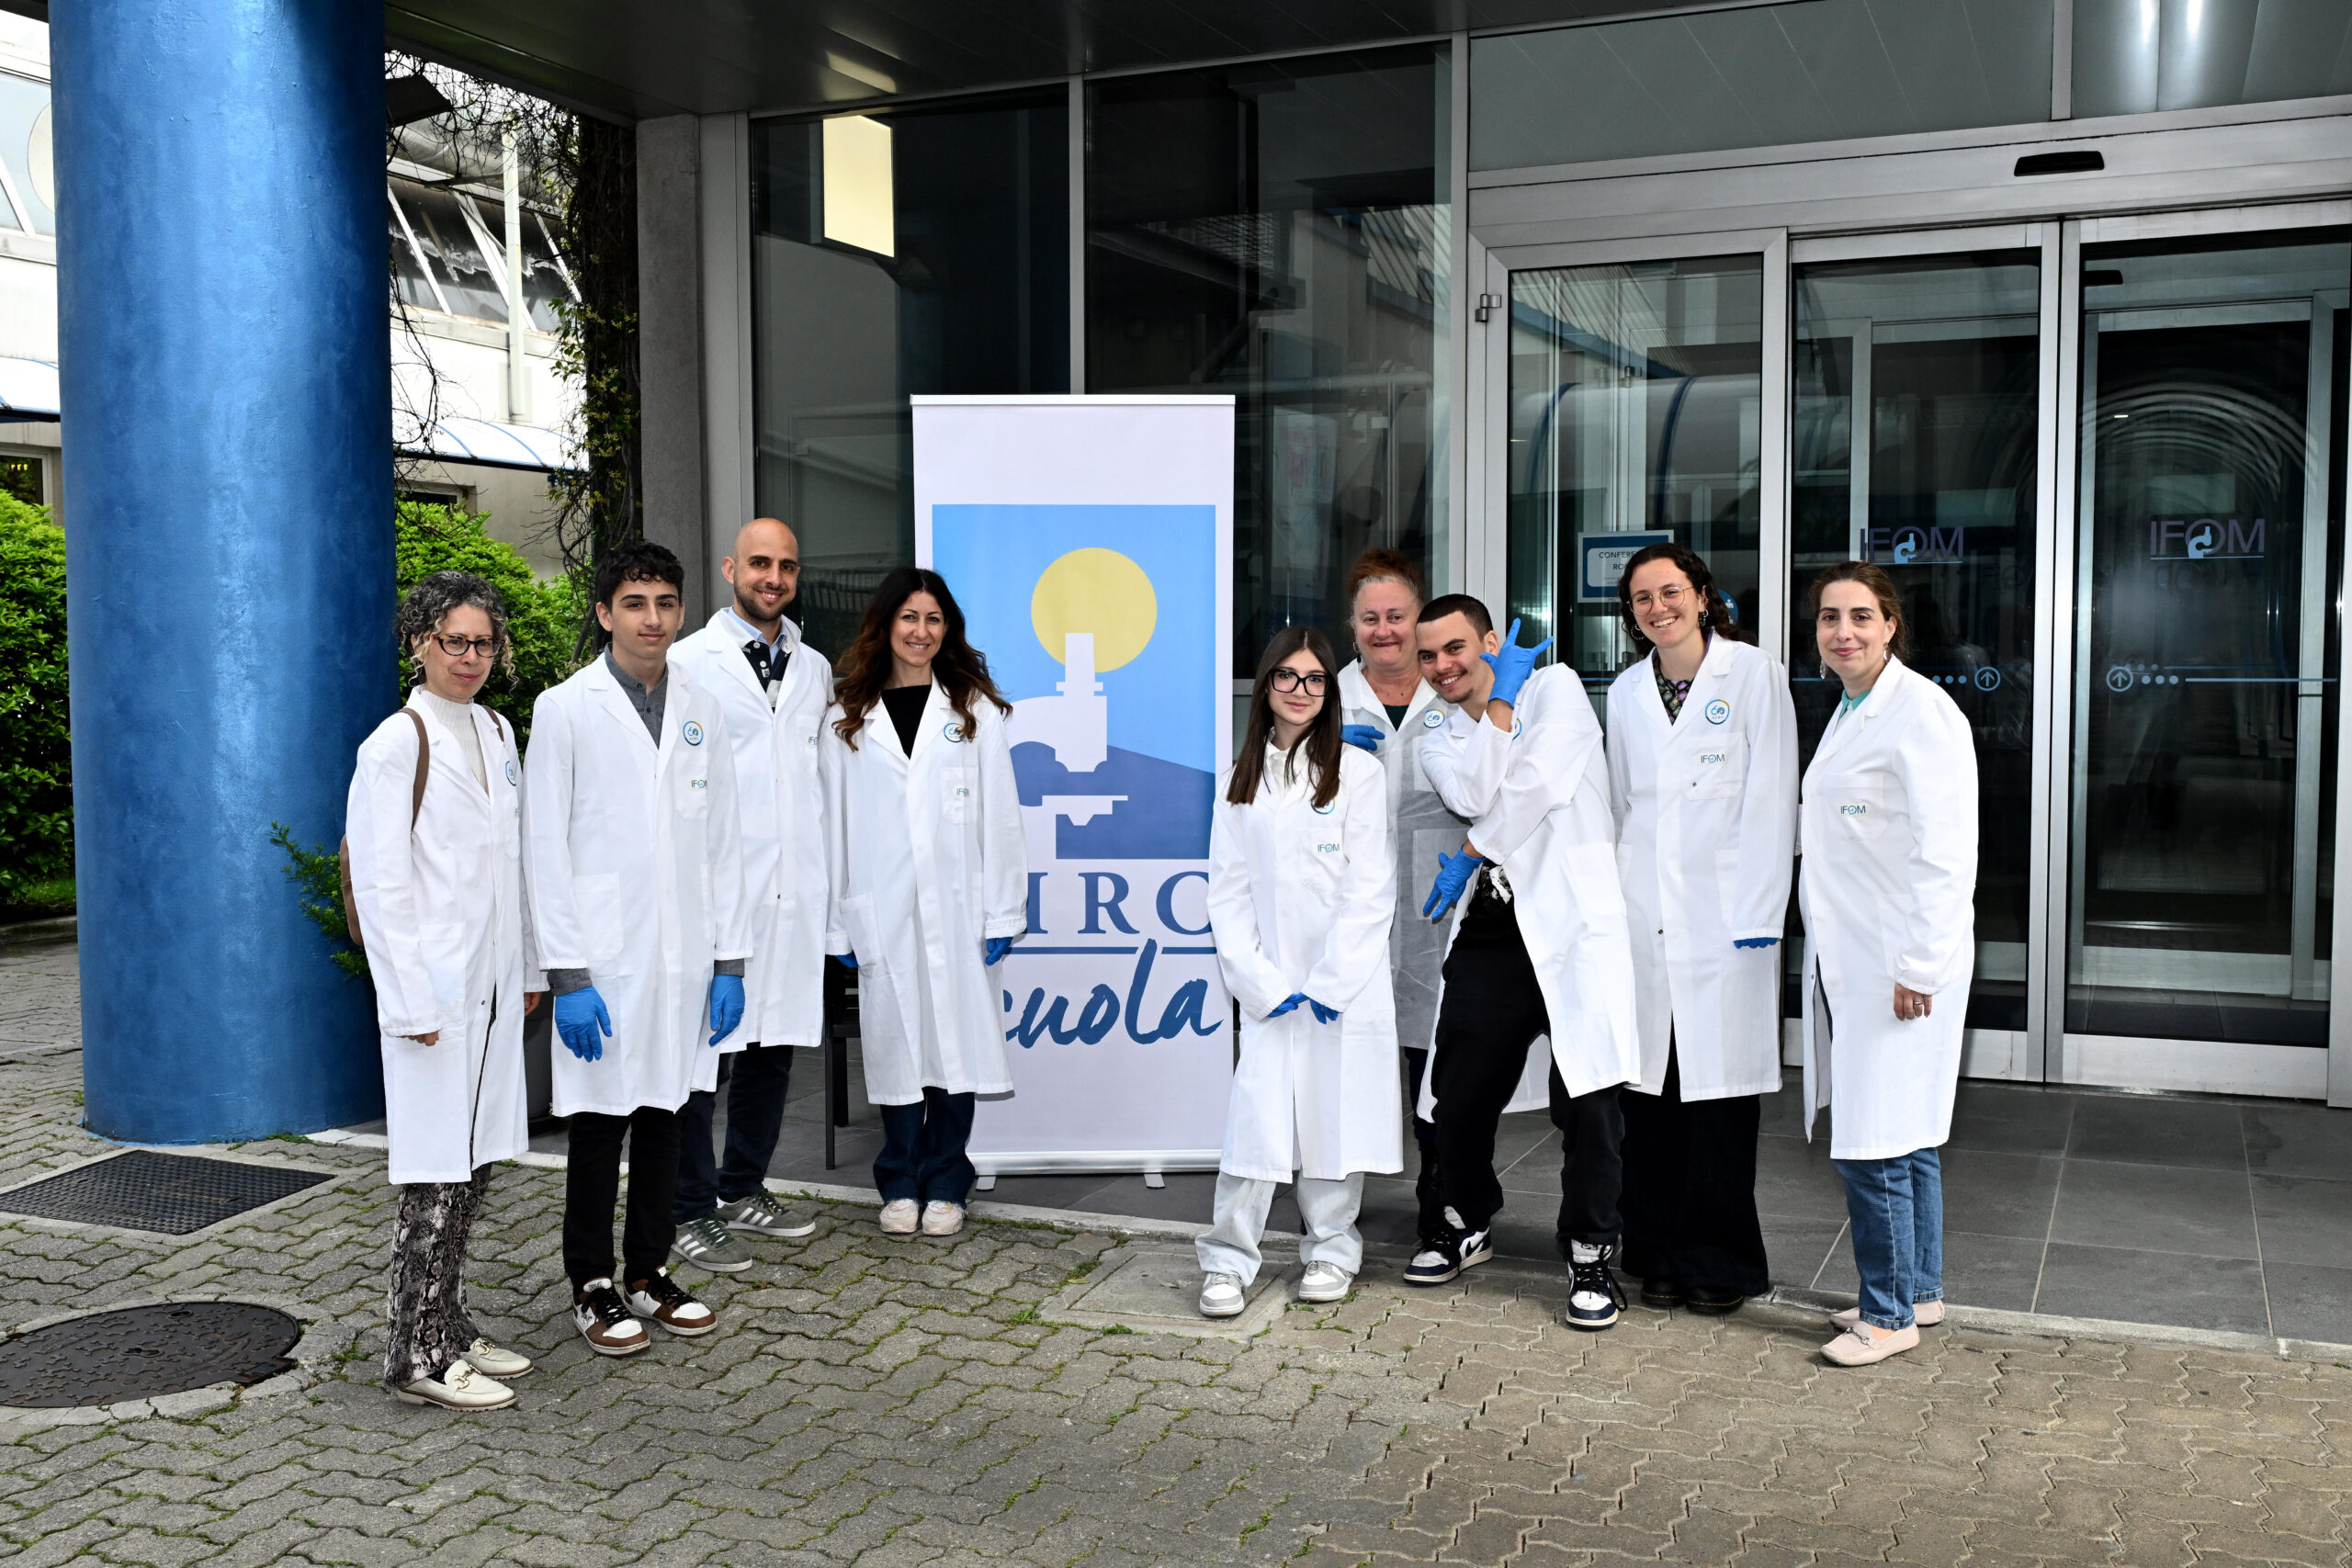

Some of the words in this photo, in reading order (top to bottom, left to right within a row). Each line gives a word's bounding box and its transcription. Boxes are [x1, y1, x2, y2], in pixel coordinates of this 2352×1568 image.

[1860, 525, 1964, 560] IFOM
[2149, 518, 2266, 556] IFOM
[1701, 753, 1725, 763] IFOM
[1840, 805, 1867, 815] IFOM
[1317, 843, 1340, 852] IFOM
[1026, 871, 1213, 935] IRC
